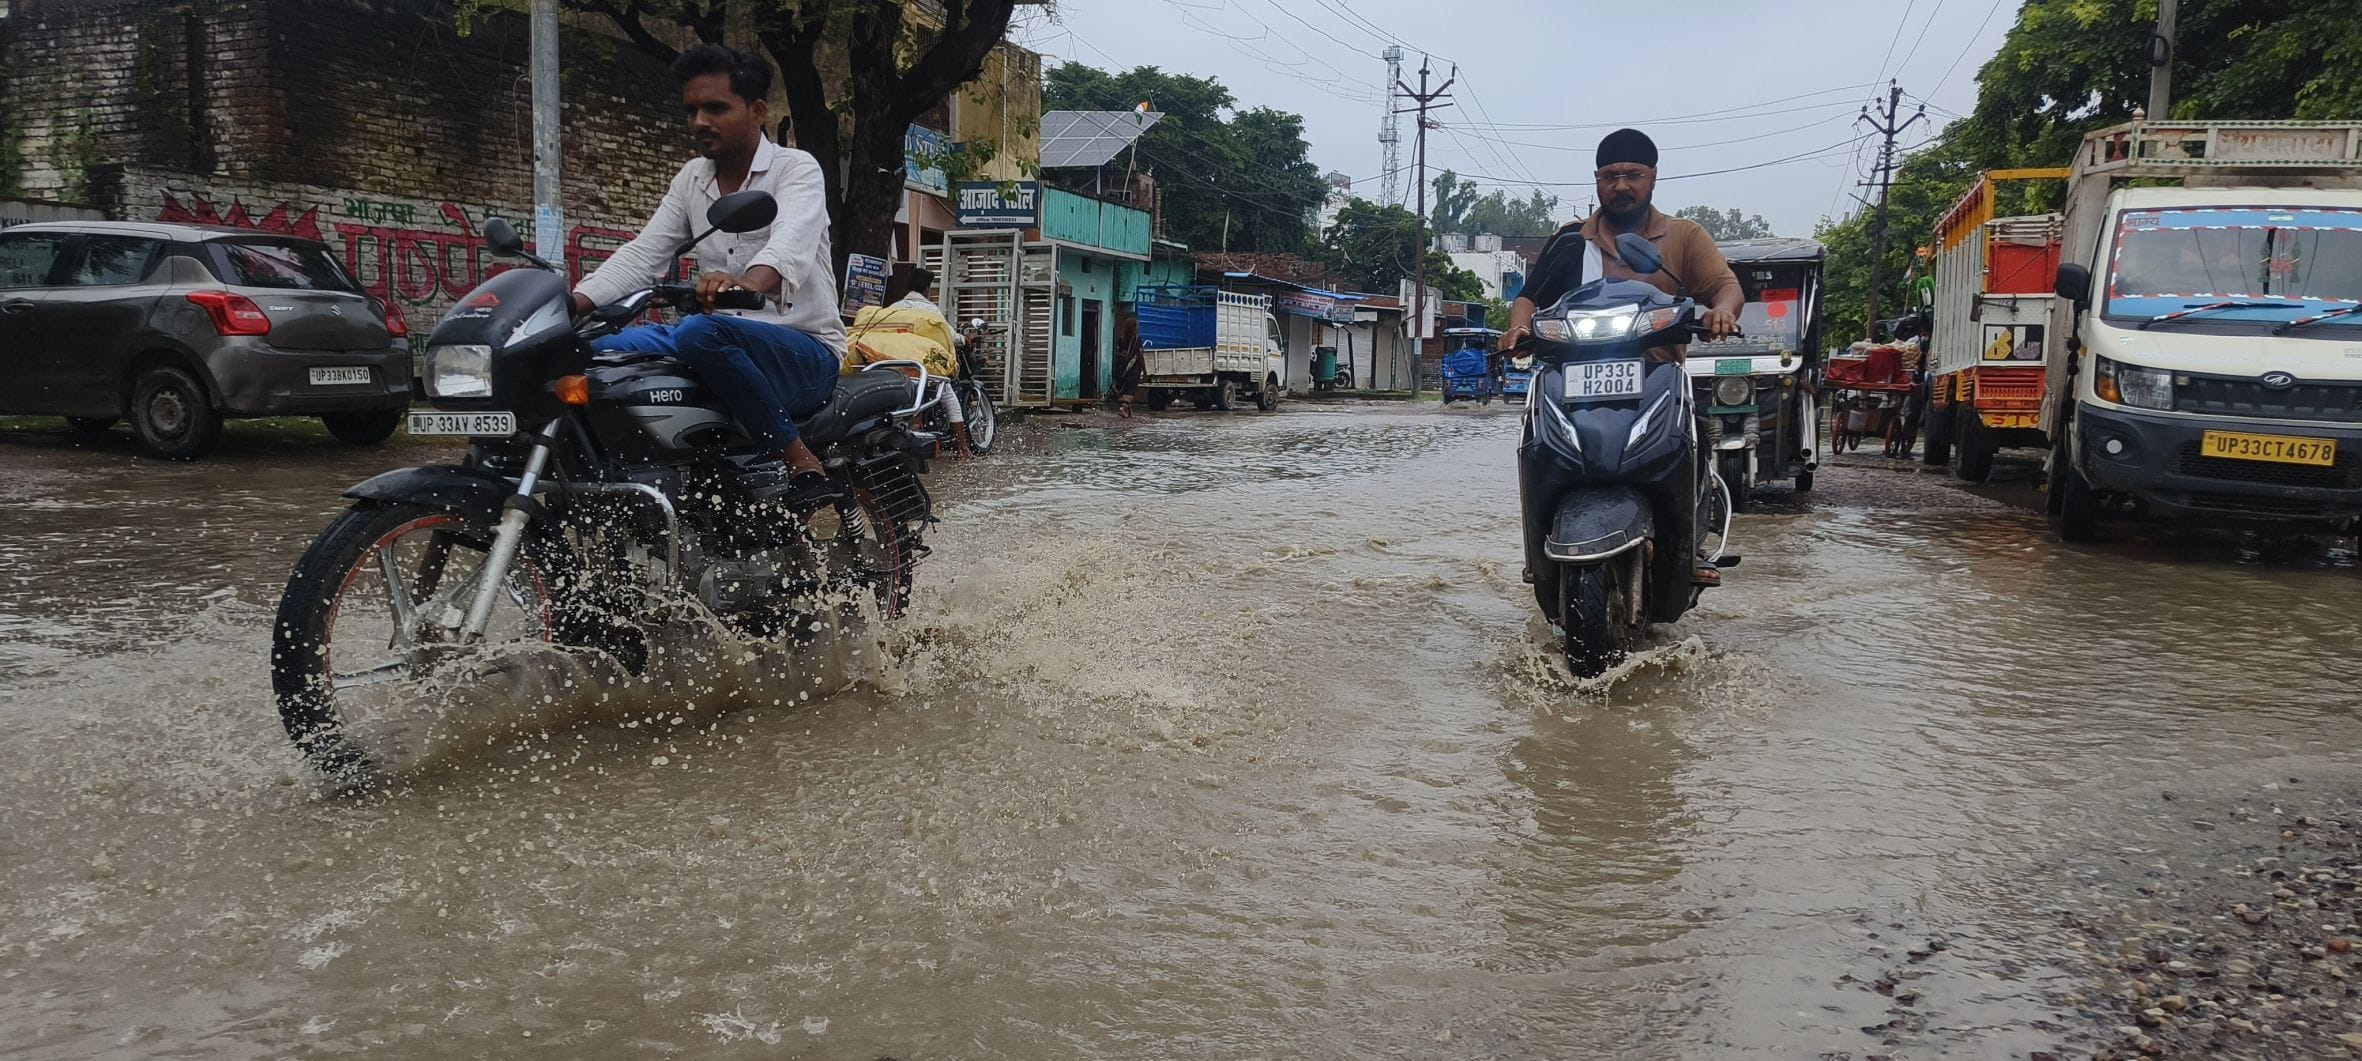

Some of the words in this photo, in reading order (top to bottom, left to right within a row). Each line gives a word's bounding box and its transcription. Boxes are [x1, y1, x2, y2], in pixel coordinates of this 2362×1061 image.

[315, 367, 369, 381] UP33BK0150
[1583, 363, 1635, 379] UP33C
[1583, 379, 1634, 395] H2004
[650, 388, 683, 403] Hero
[419, 416, 434, 433] UP
[438, 416, 469, 433] 33AV
[474, 416, 509, 432] 8539
[2216, 436, 2333, 461] UP33CT4678
